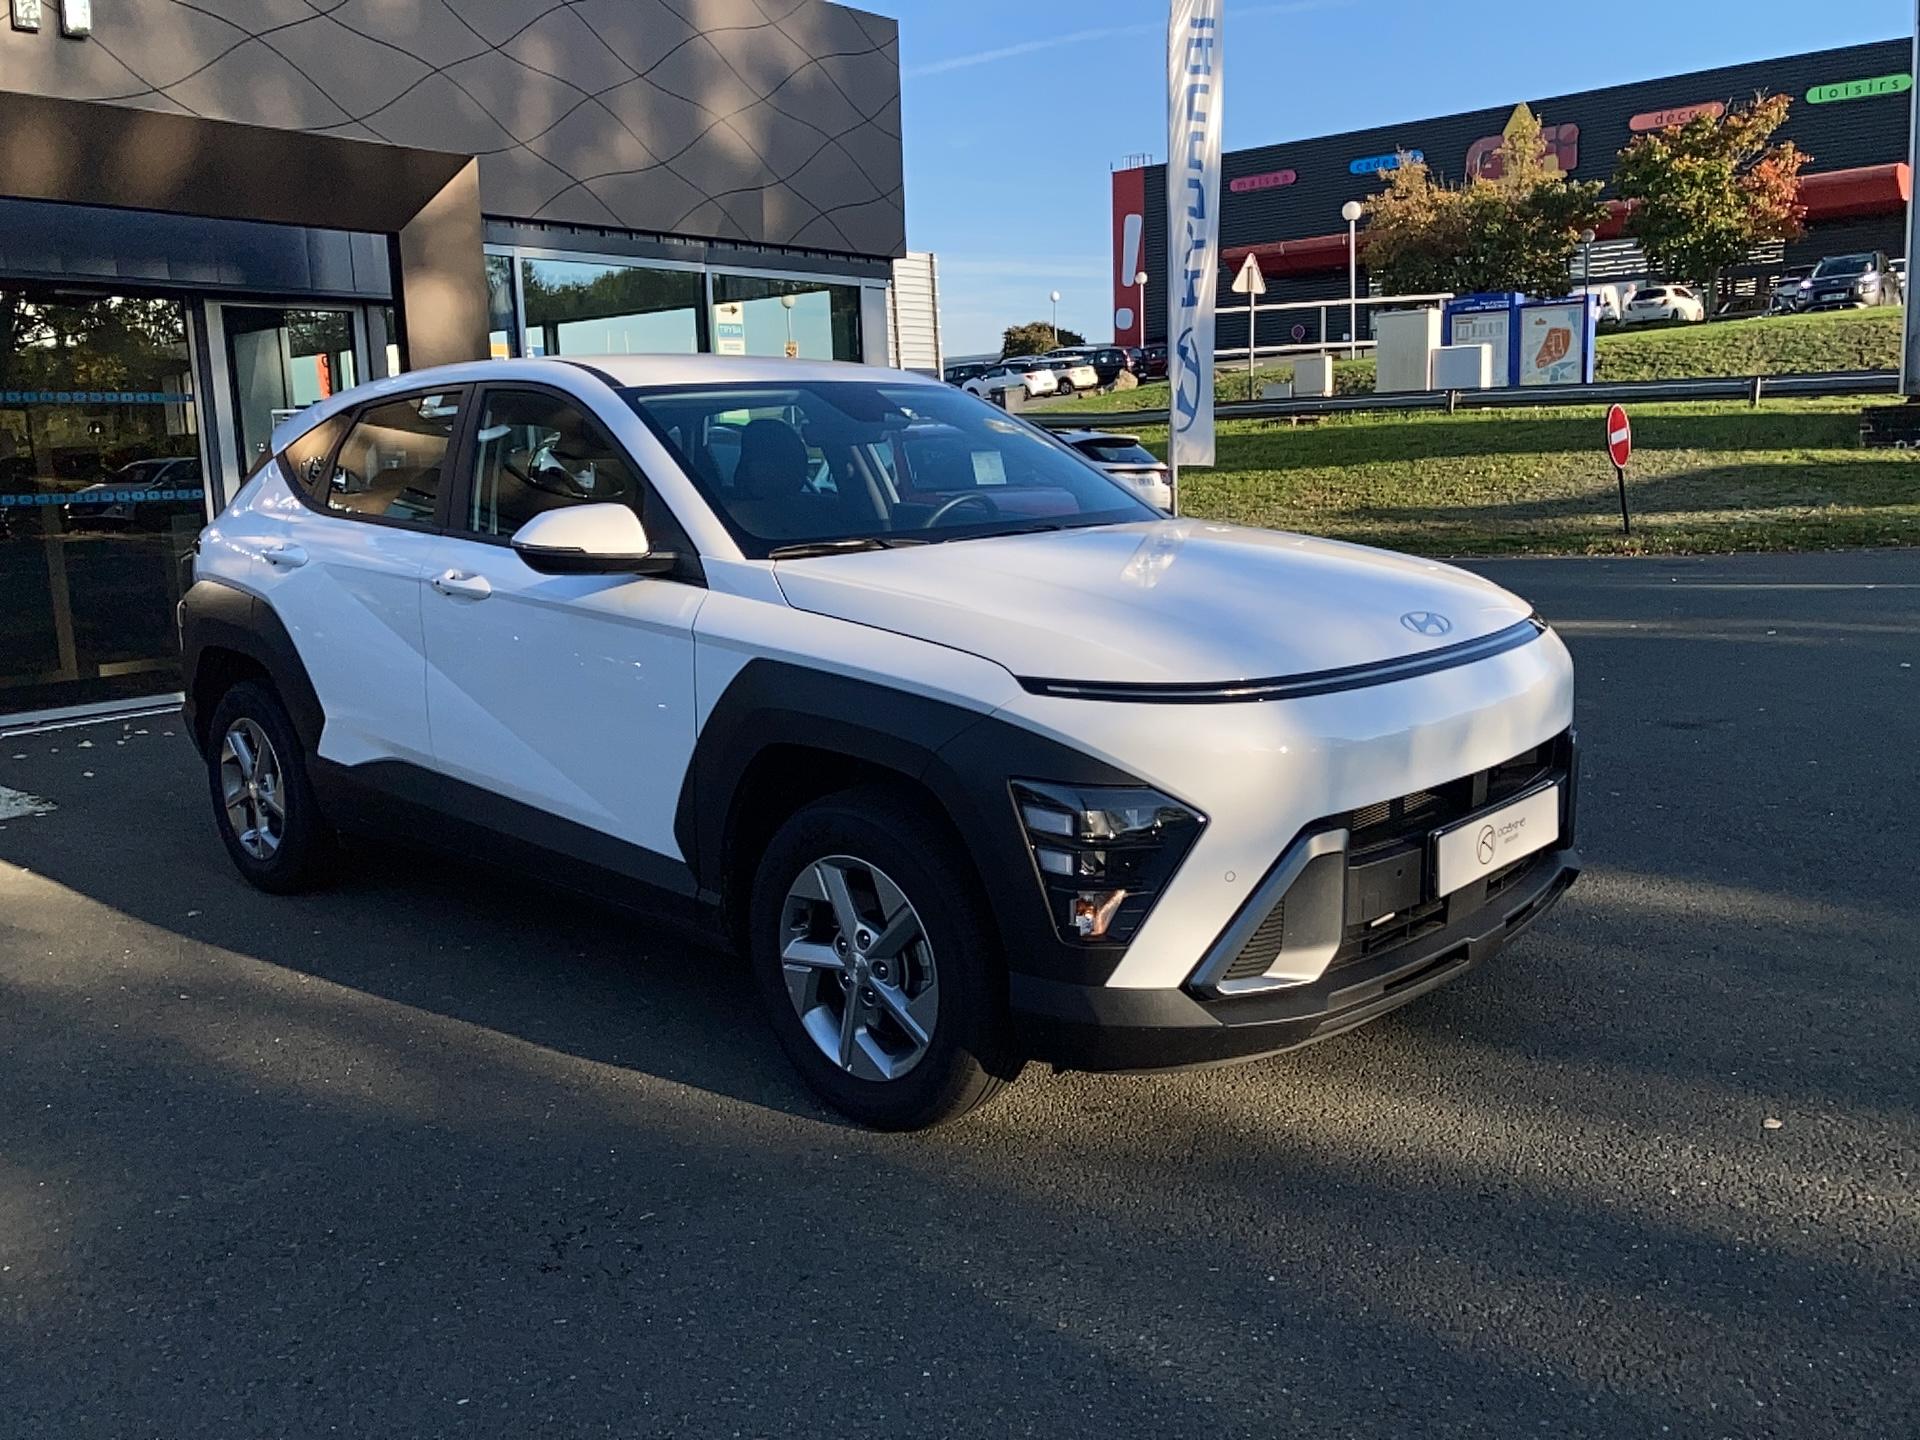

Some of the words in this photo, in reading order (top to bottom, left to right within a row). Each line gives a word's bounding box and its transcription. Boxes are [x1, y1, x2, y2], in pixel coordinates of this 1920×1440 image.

[1818, 80, 1899, 99] loisirs
[1181, 17, 1215, 308] HYUNDAI
[1236, 174, 1290, 188] maison
